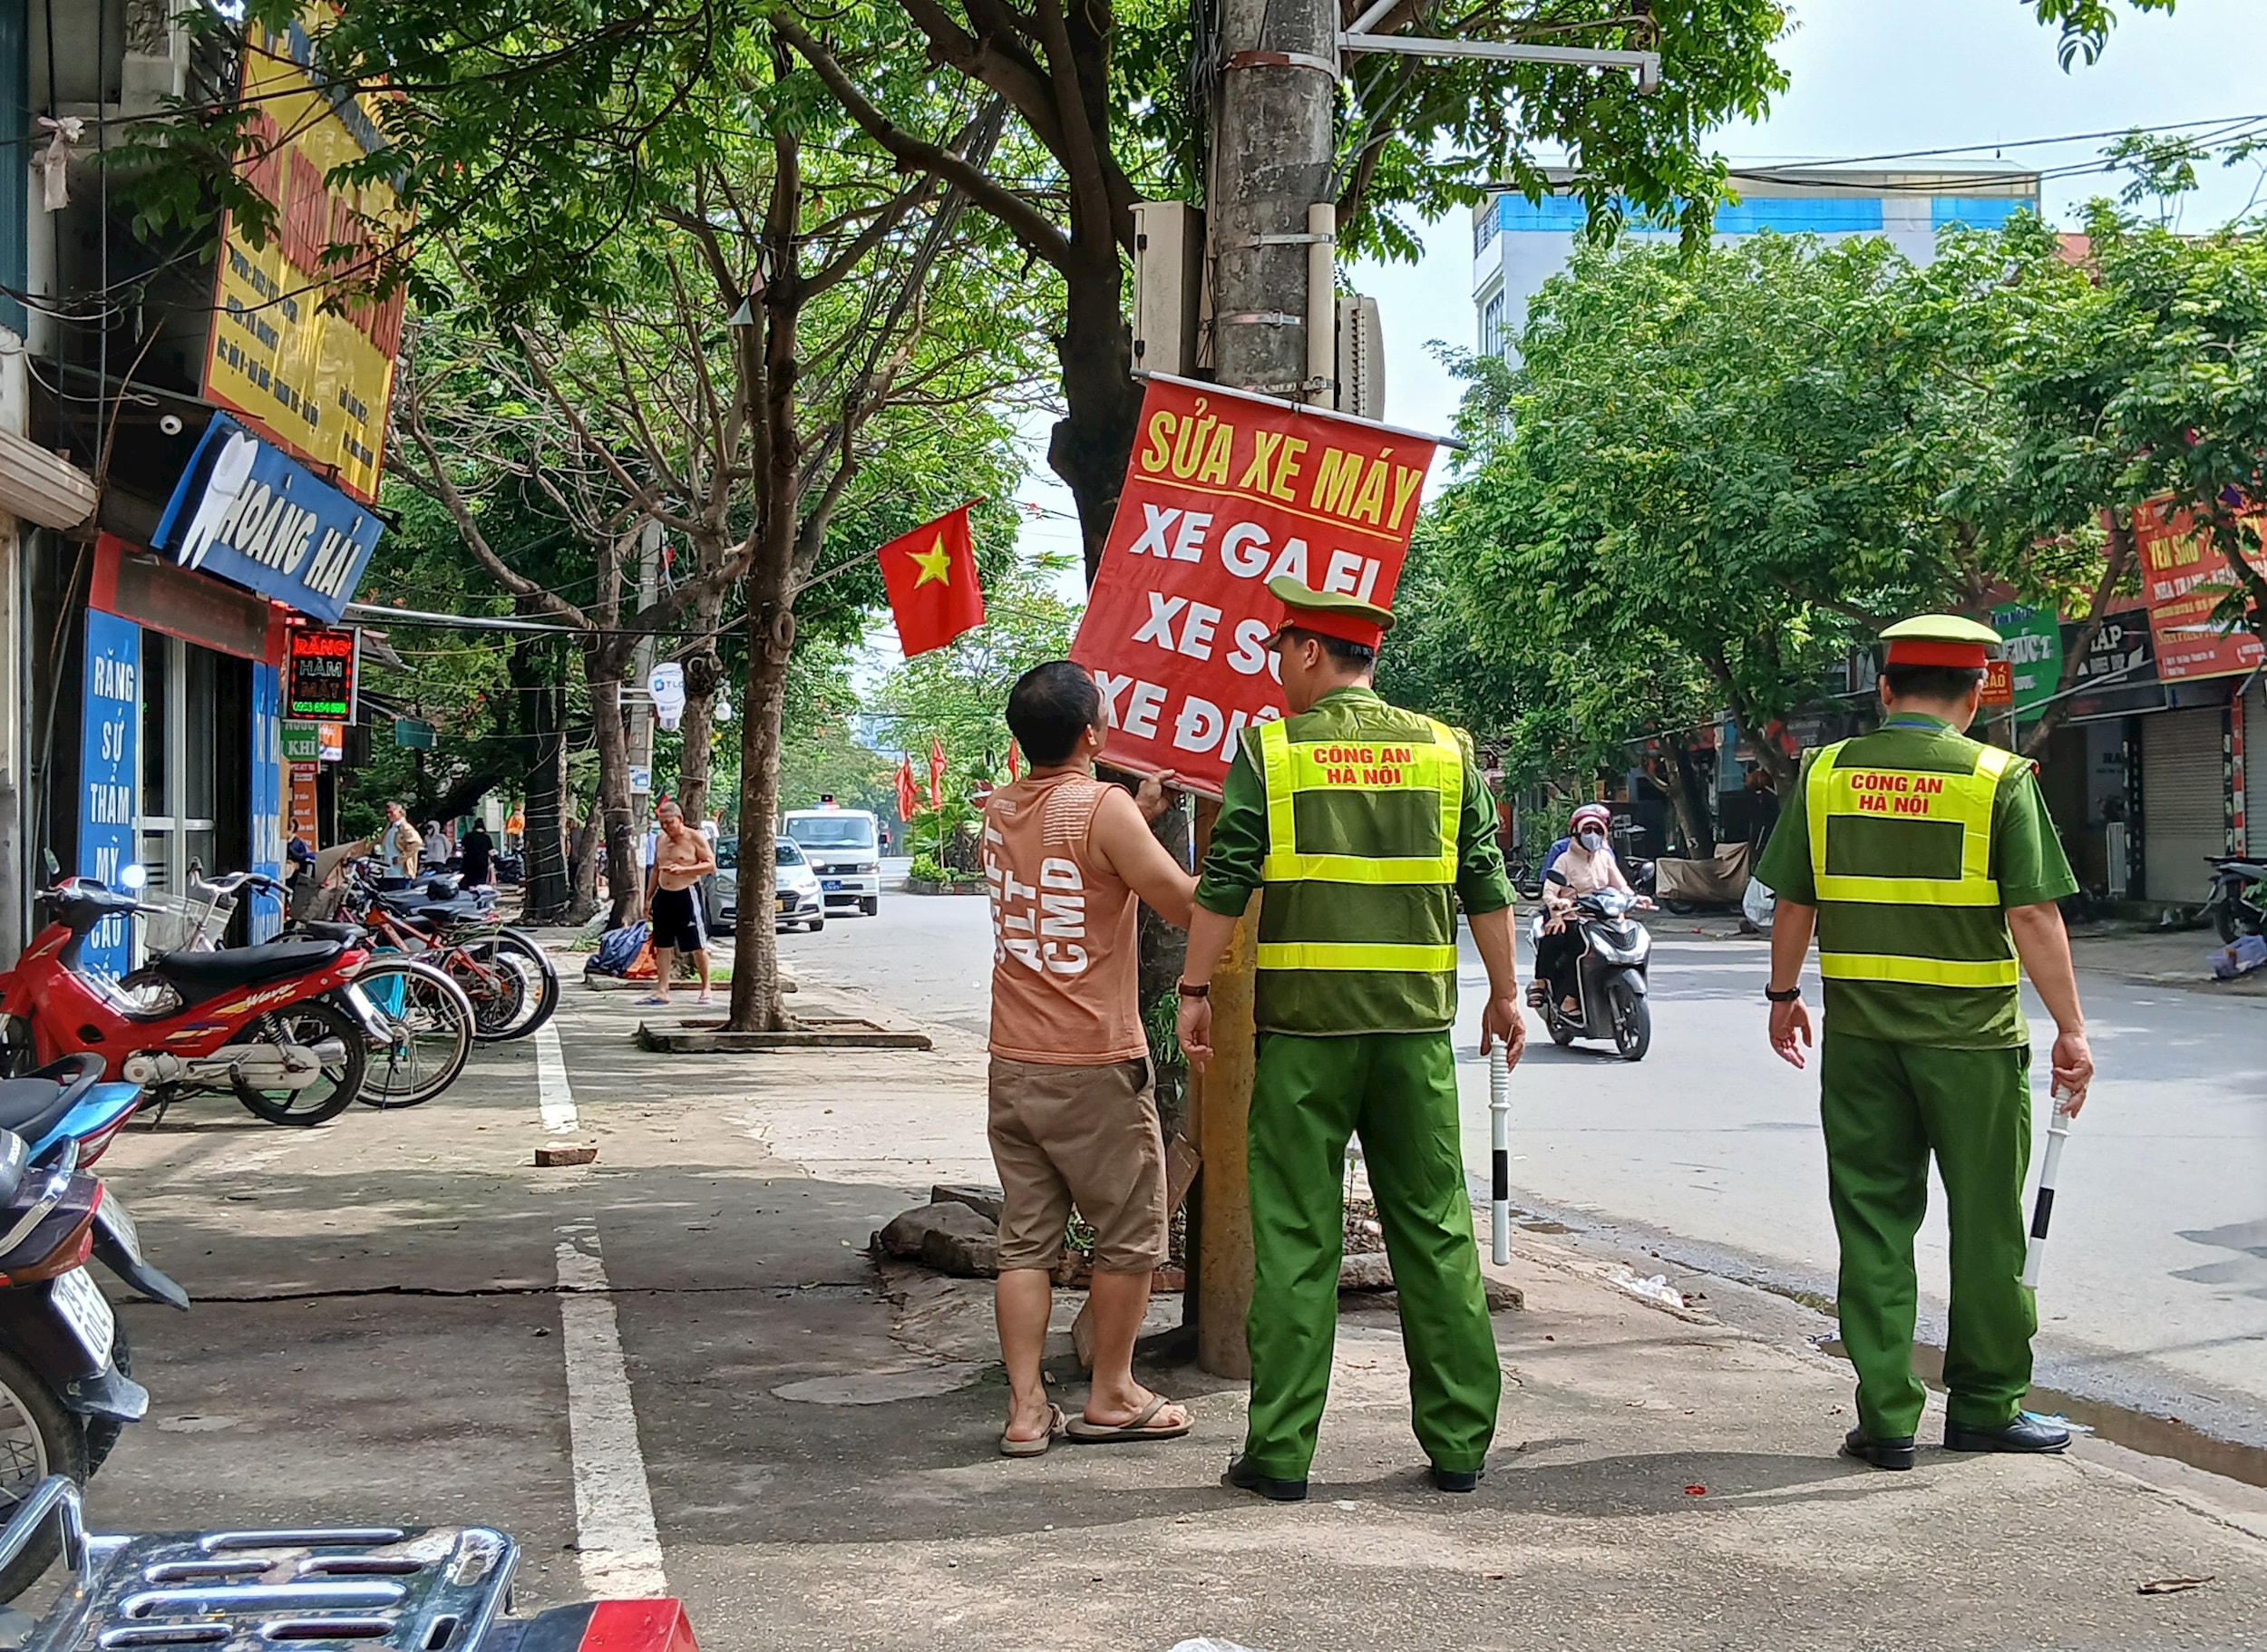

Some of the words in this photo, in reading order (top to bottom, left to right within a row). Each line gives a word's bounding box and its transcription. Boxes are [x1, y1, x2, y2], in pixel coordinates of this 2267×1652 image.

[1141, 396, 1234, 485] SỬA
[1238, 431, 1309, 502] XE
[1309, 448, 1423, 531] MÁY
[214, 474, 317, 575] HOÀNG
[1129, 503, 1213, 563] XE
[1221, 521, 1308, 586] GA
[293, 635, 349, 656] RĂNG
[1132, 591, 1222, 661] XE
[1226, 619, 1283, 685] S
[93, 646, 134, 703] RĂNG
[298, 656, 343, 677] HÀM
[1094, 669, 1168, 740] XE
[102, 707, 124, 762] SỨ
[288, 736, 316, 755] KHÍ
[1313, 745, 1374, 763] CÔNG
[1381, 748, 1411, 763] AN
[90, 763, 131, 824] THẨM
[1327, 765, 1357, 784] HÀ
[1363, 765, 1402, 788] NỘI
[1851, 772, 1908, 792] CÔNG
[1913, 777, 1943, 794] AN
[1859, 792, 1887, 811] HÀ
[1894, 794, 1929, 816] NỘI
[95, 835, 120, 887] MỸ
[1004, 870, 1044, 973] ALT
[1040, 857, 1089, 975] CMD
